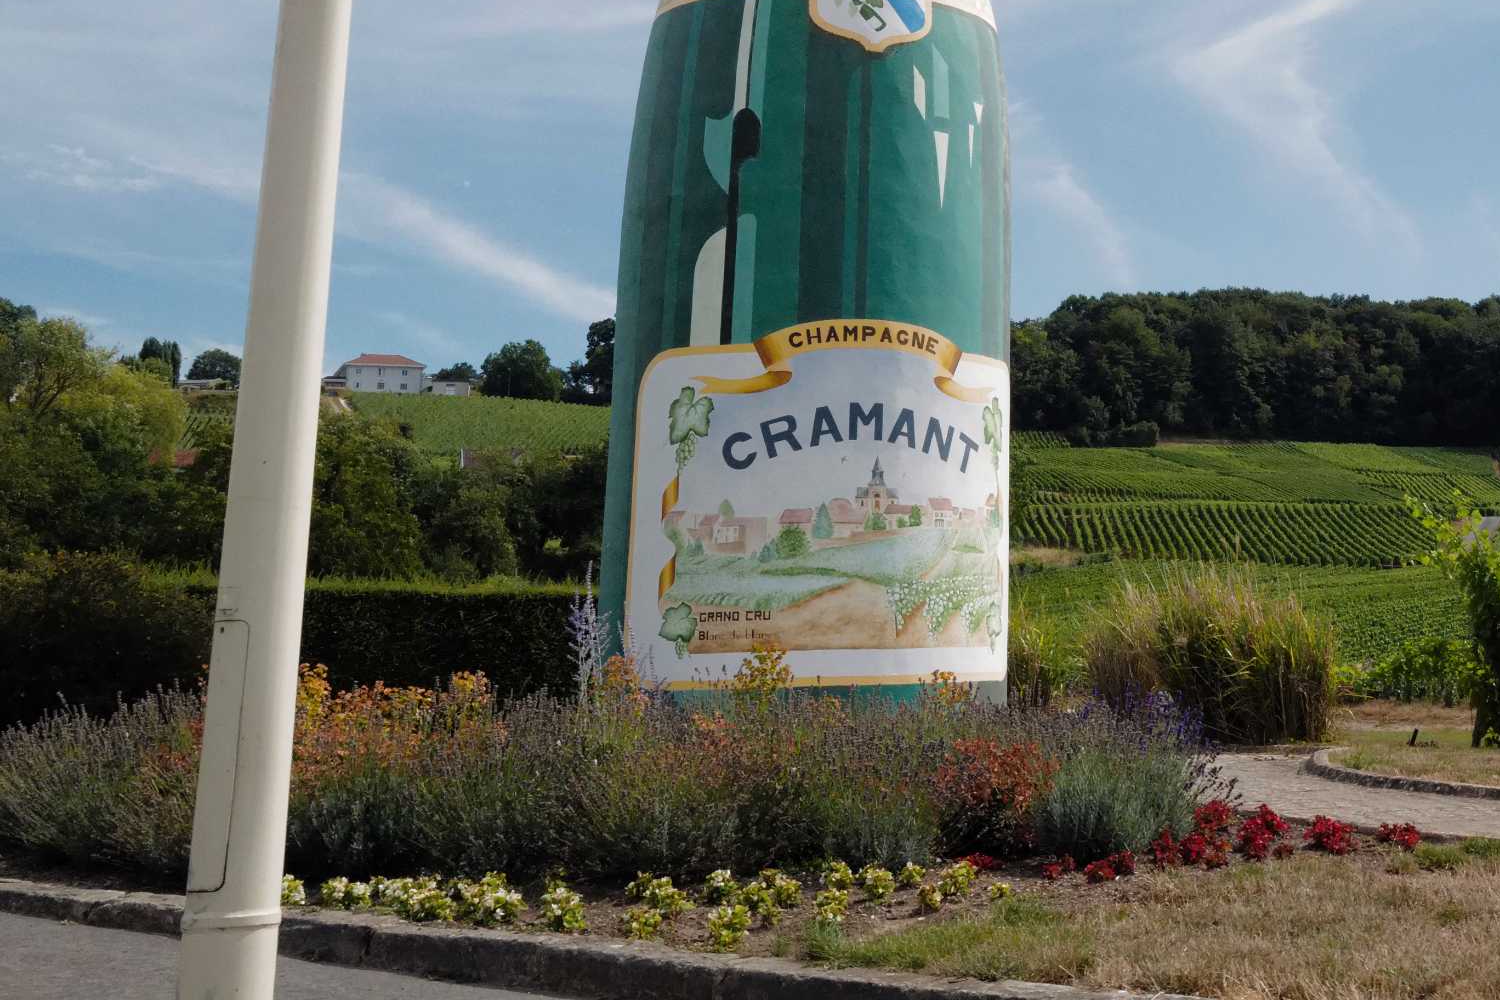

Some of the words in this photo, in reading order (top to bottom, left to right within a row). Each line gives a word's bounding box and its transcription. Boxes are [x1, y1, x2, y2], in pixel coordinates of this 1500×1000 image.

[789, 325, 938, 354] CHAMPAGNE
[722, 401, 979, 473] CRAMANT
[699, 611, 740, 622] GRAND
[745, 610, 771, 621] CRU
